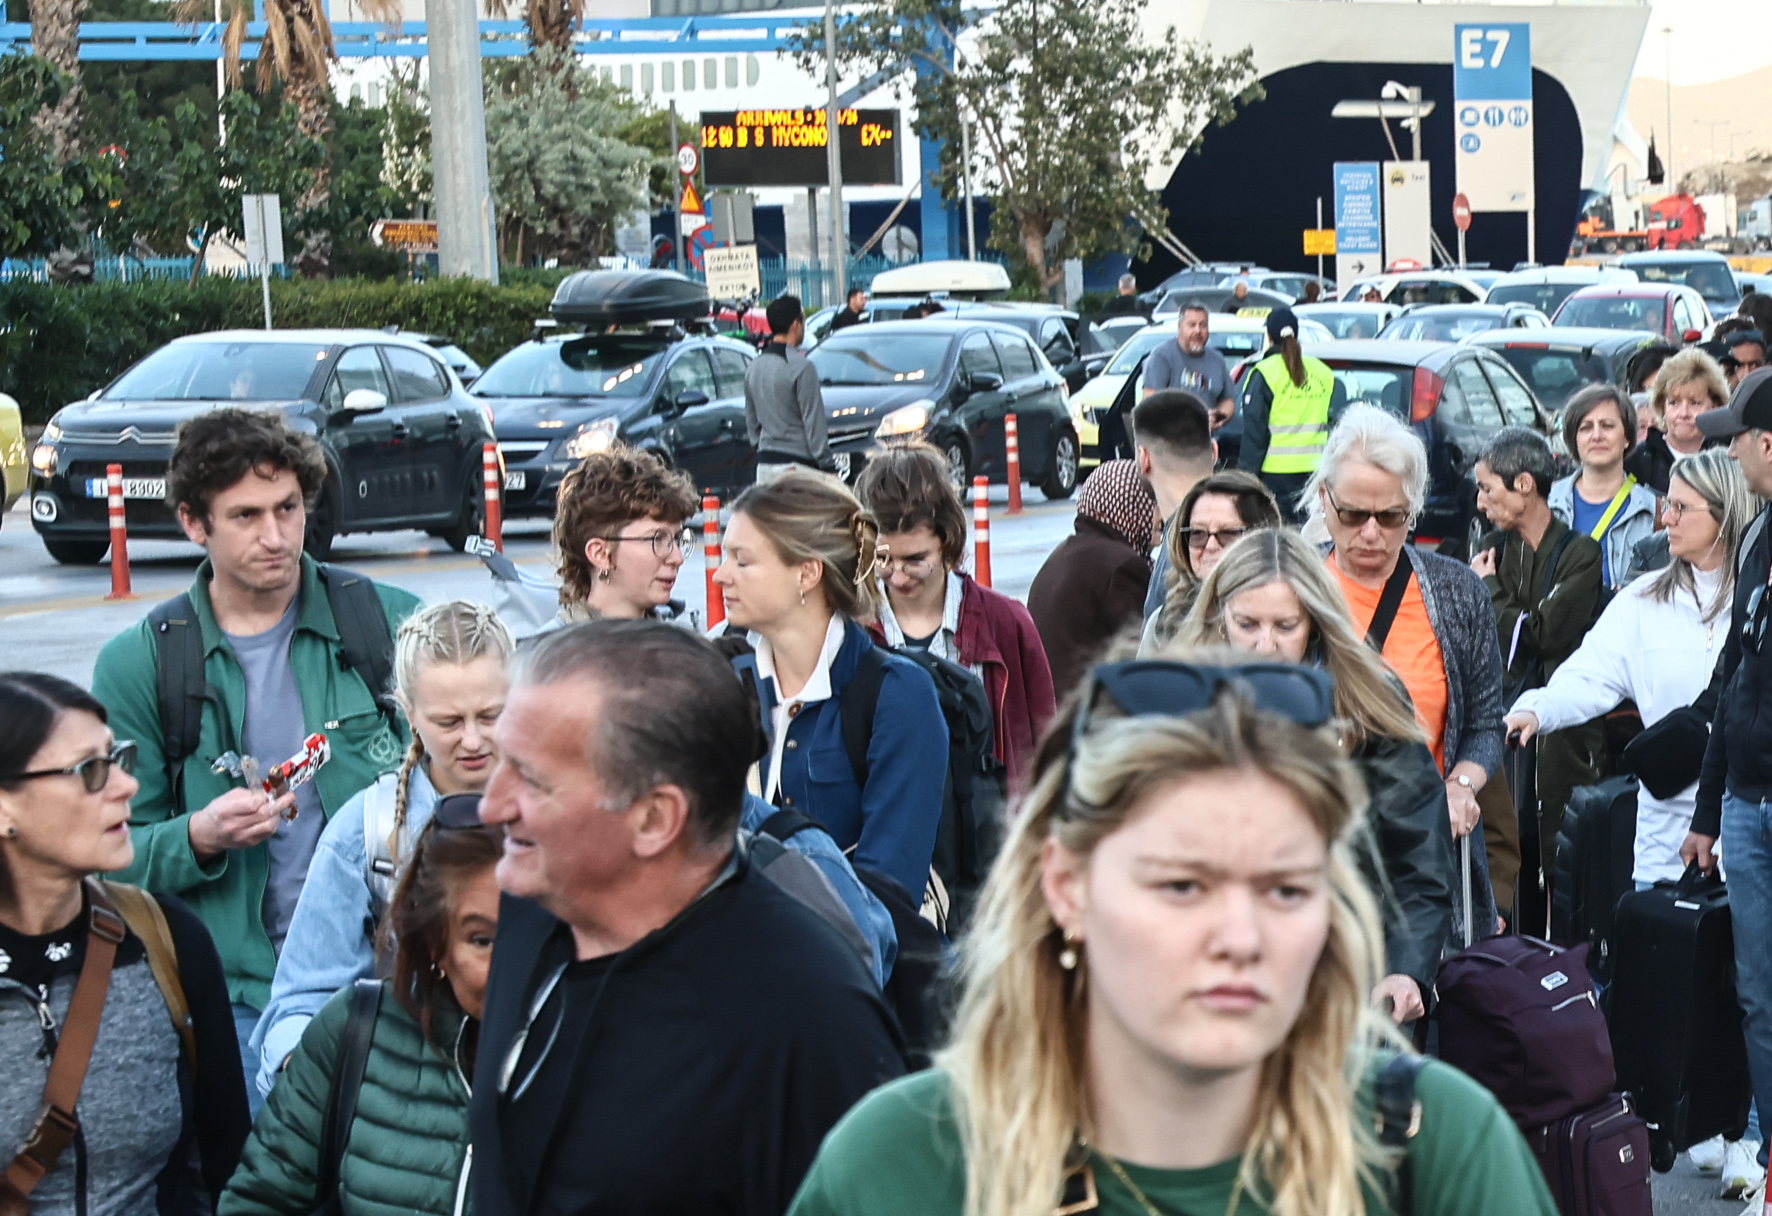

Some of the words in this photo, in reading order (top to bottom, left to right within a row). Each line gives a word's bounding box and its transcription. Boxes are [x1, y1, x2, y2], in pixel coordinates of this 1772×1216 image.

[1460, 29, 1510, 68] E7
[736, 109, 804, 126] ARRIVALS
[771, 124, 829, 147] MYCONO
[681, 152, 695, 166] 30
